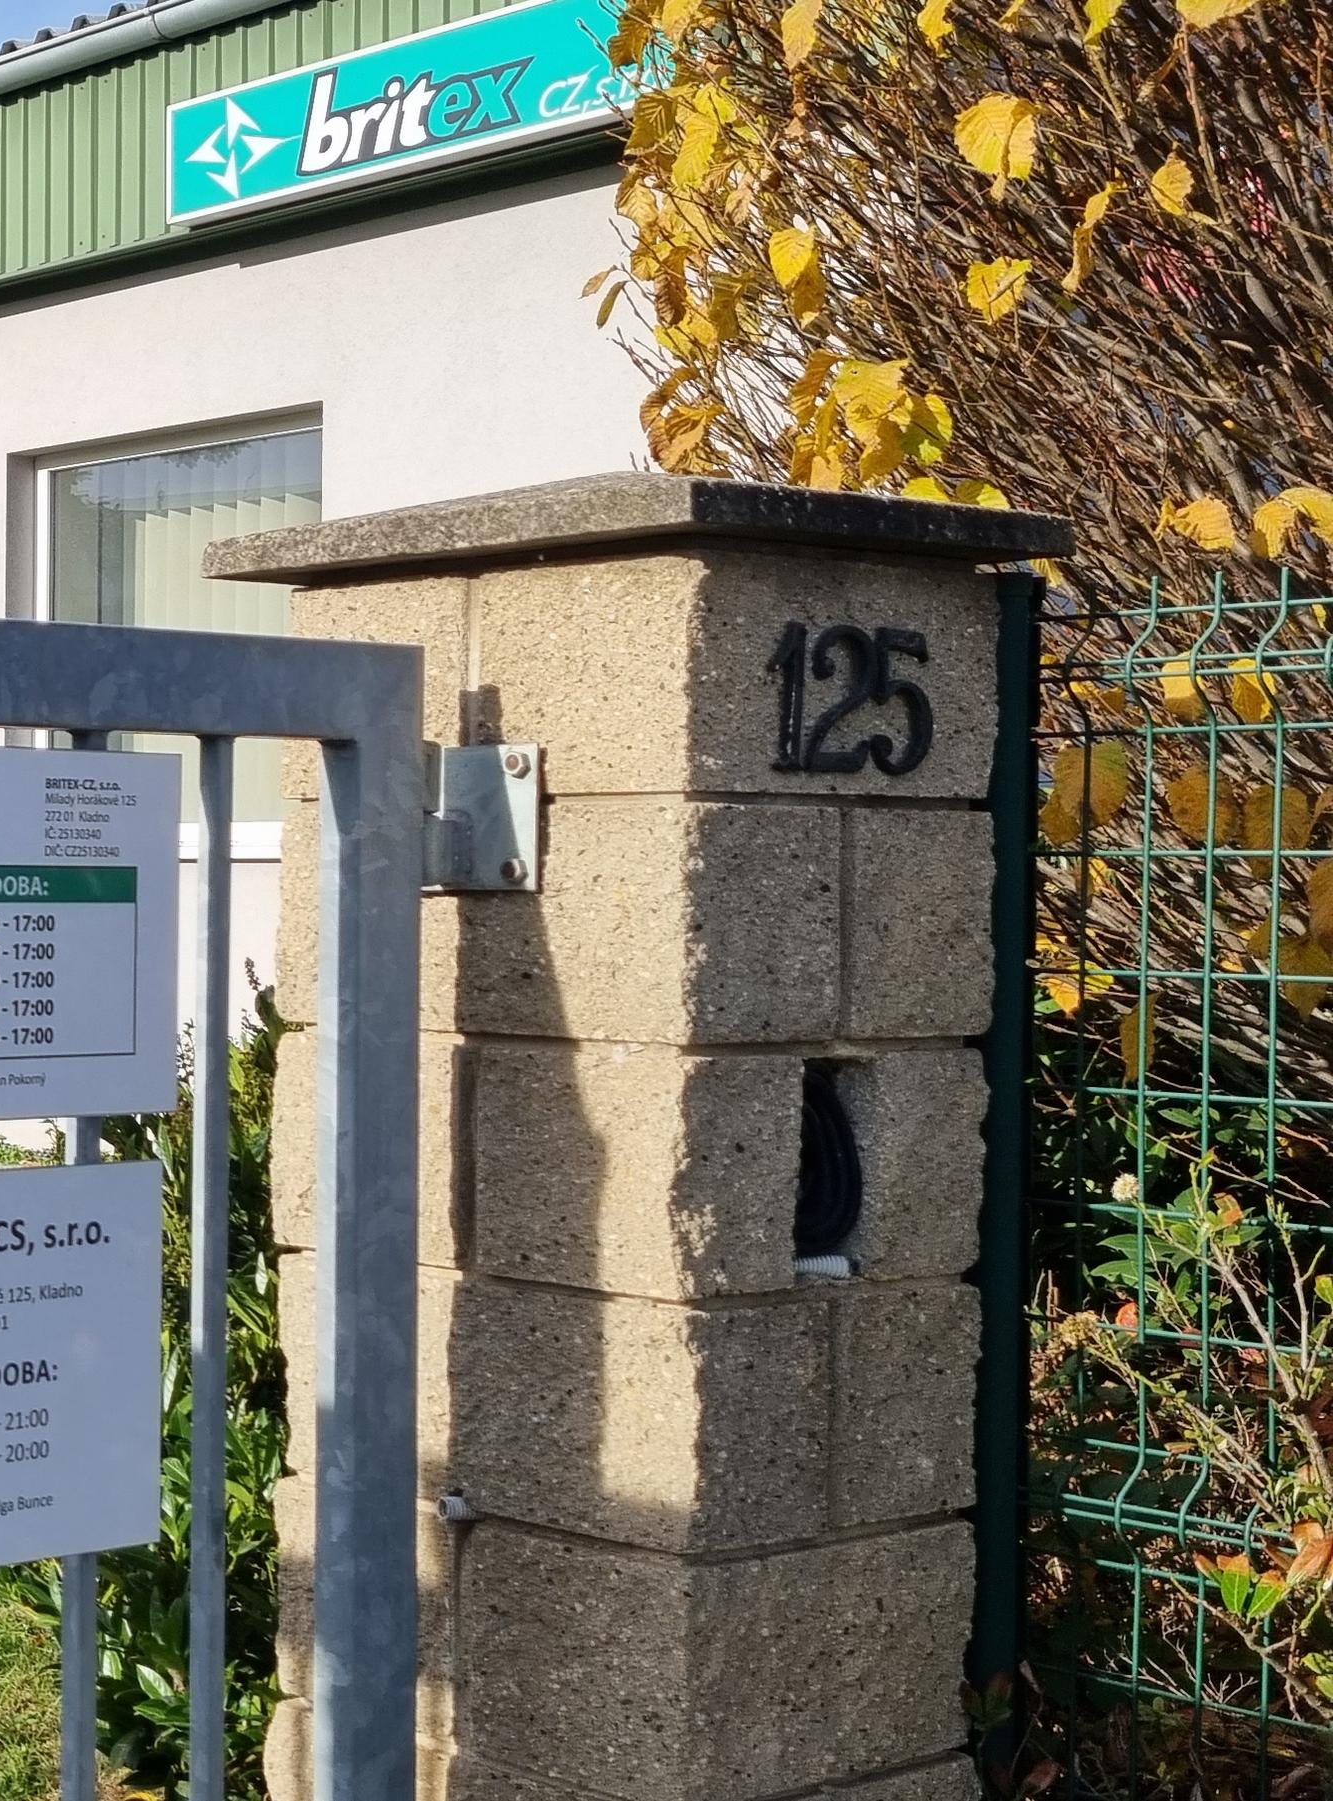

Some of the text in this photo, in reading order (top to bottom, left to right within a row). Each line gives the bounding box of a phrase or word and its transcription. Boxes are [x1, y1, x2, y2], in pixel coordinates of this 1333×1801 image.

[297, 56, 535, 175] britex
[767, 619, 935, 776] 125
[45, 778, 121, 790] BRITEX-CZ, s.r.o.
[45, 793, 136, 807] Milady Horákové 125
[45, 811, 109, 822] 272 01 Kladno
[12, 914, 55, 931] 17:00
[12, 942, 55, 961] 17:00
[12, 970, 55, 989] 17:00
[12, 999, 55, 1017] 17:00
[12, 1027, 55, 1046] 17:00
[9, 1071, 46, 1088] Pokorný
[44, 1221, 110, 1247] s.r.o.
[8, 1286, 35, 1304] 125,
[38, 1282, 83, 1301] Kladno
[5, 1408, 49, 1432] 21:00
[5, 1441, 50, 1464] 20:00
[17, 1492, 53, 1511] Bunce
